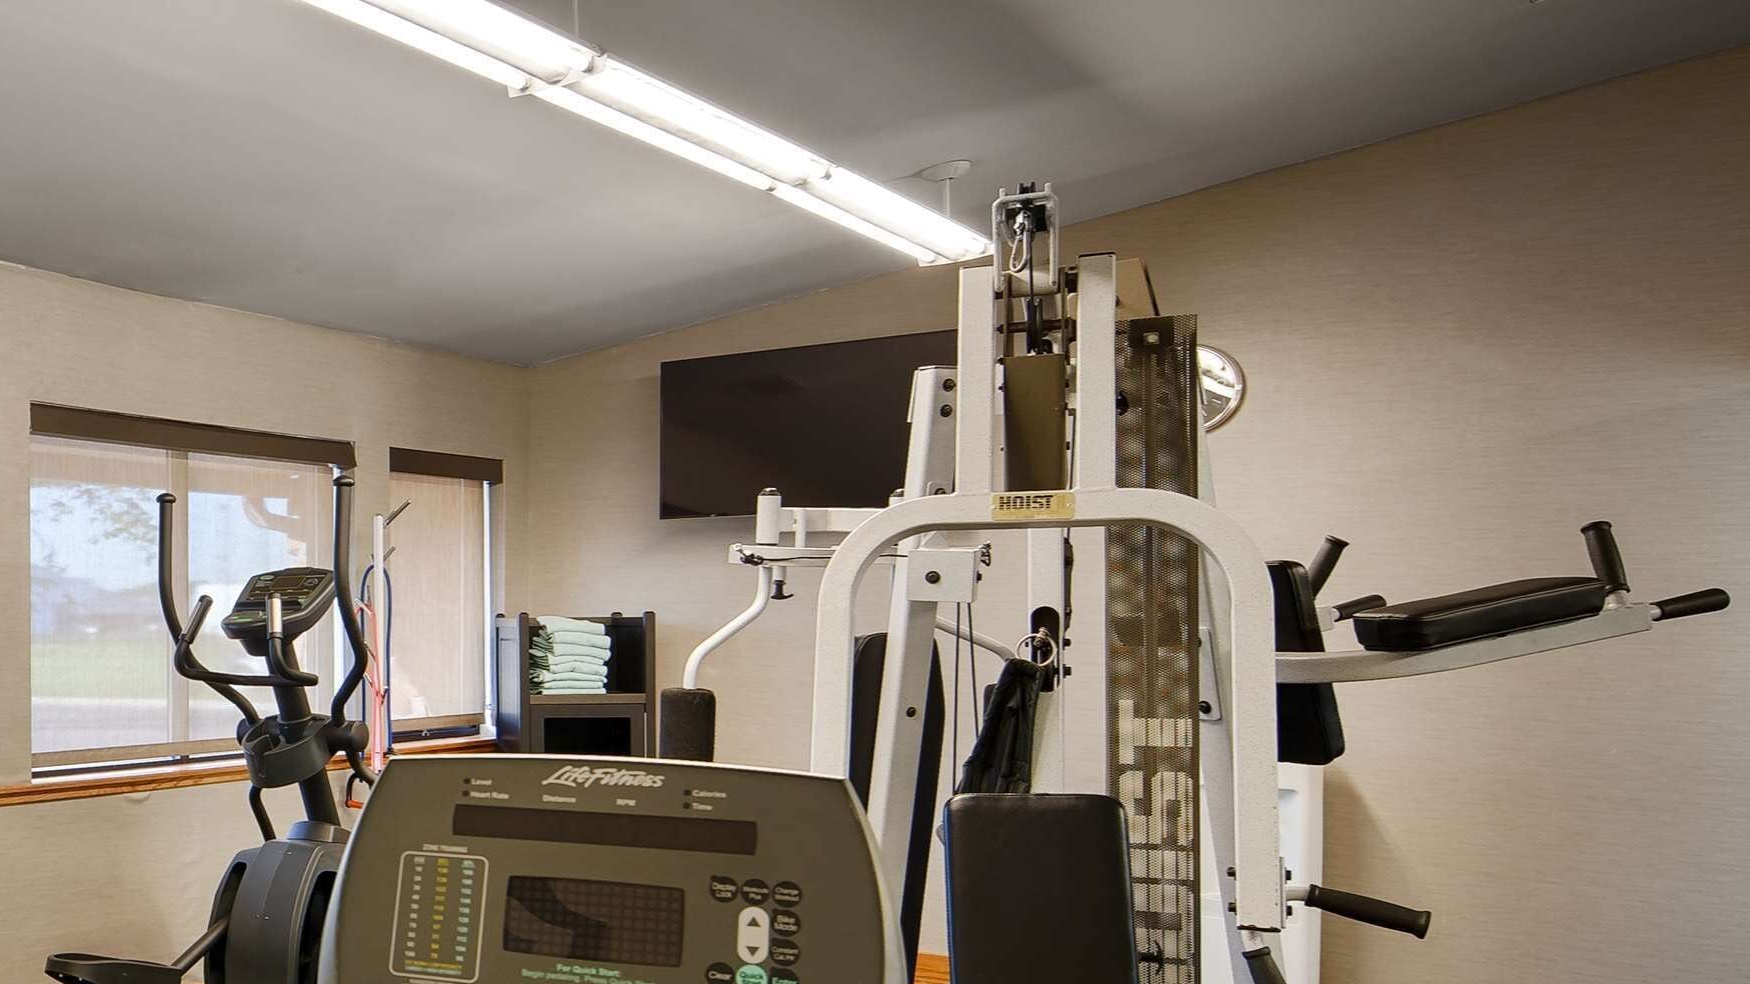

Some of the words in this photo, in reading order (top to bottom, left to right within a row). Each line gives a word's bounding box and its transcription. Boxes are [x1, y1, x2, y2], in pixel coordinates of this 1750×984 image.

[999, 495, 1054, 510] HOIST
[572, 965, 596, 975] Quick
[708, 971, 733, 980] Clear
[739, 971, 763, 980] Quick
